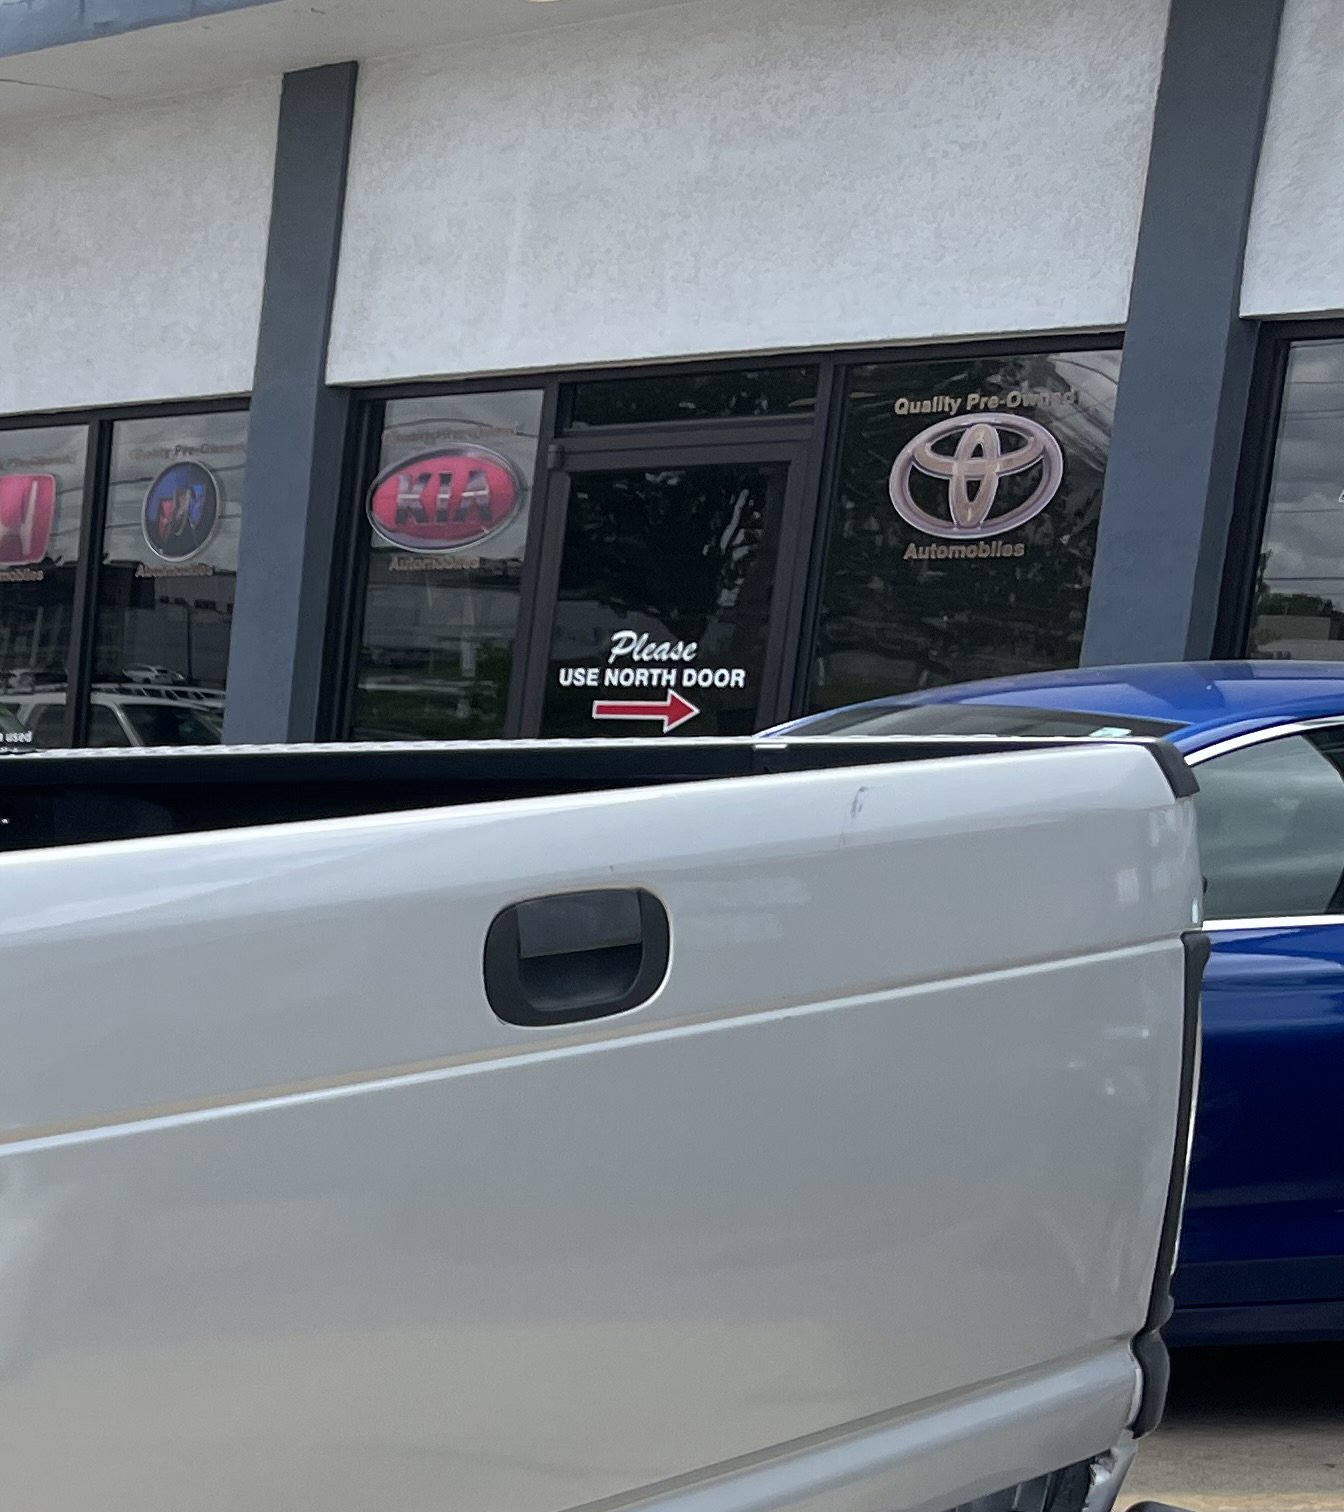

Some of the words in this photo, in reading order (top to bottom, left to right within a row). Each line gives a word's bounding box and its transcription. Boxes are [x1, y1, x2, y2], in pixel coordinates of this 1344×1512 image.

[894, 396, 961, 415] Quality
[966, 391, 1078, 411] Pre-Owned
[395, 470, 493, 526] KIA
[903, 541, 1025, 560] Automobiles
[607, 630, 699, 664] Please
[559, 667, 600, 687] USE
[604, 668, 677, 688] NORTH
[682, 668, 747, 689] DOOR
[5, 730, 32, 743] used
